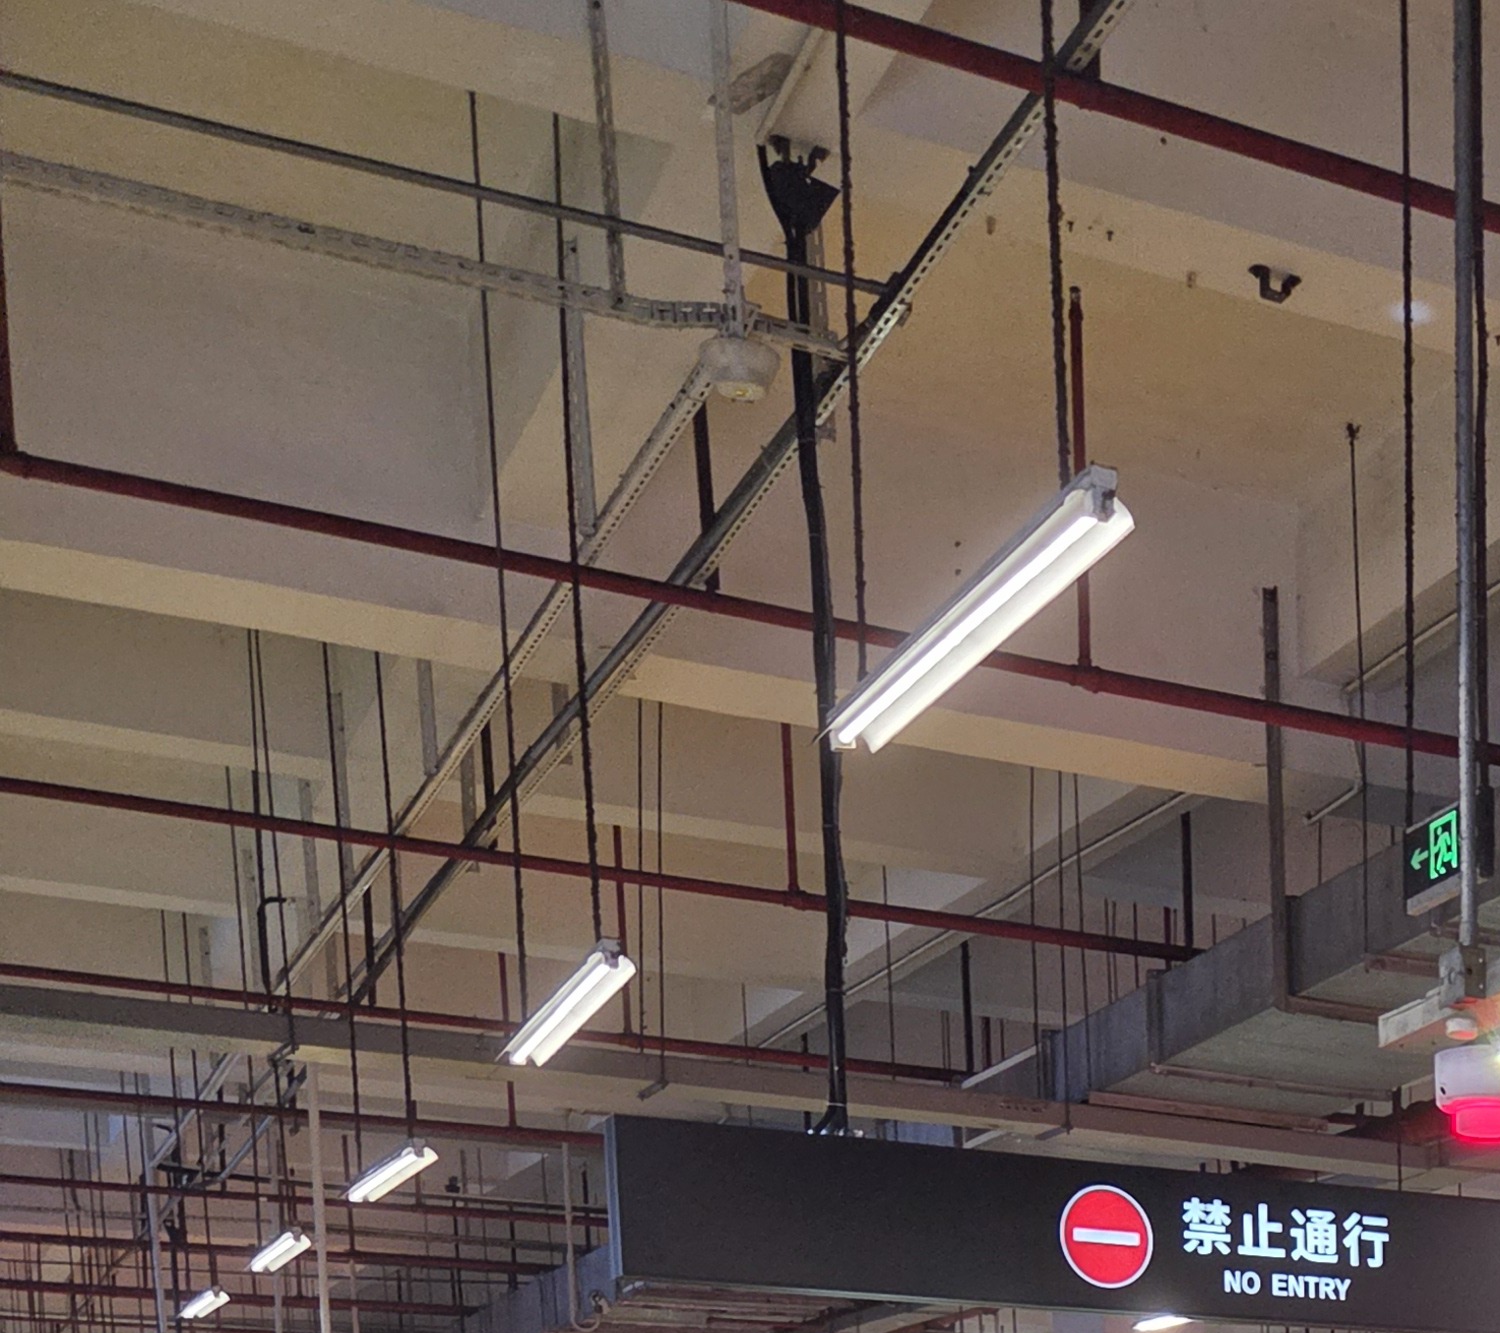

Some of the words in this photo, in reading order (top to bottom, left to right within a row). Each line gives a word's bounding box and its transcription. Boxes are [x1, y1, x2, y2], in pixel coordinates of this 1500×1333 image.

[1181, 1197, 1391, 1269] 禁止通行
[1223, 1270, 1261, 1294] NO
[1271, 1273, 1352, 1301] ENTRY
